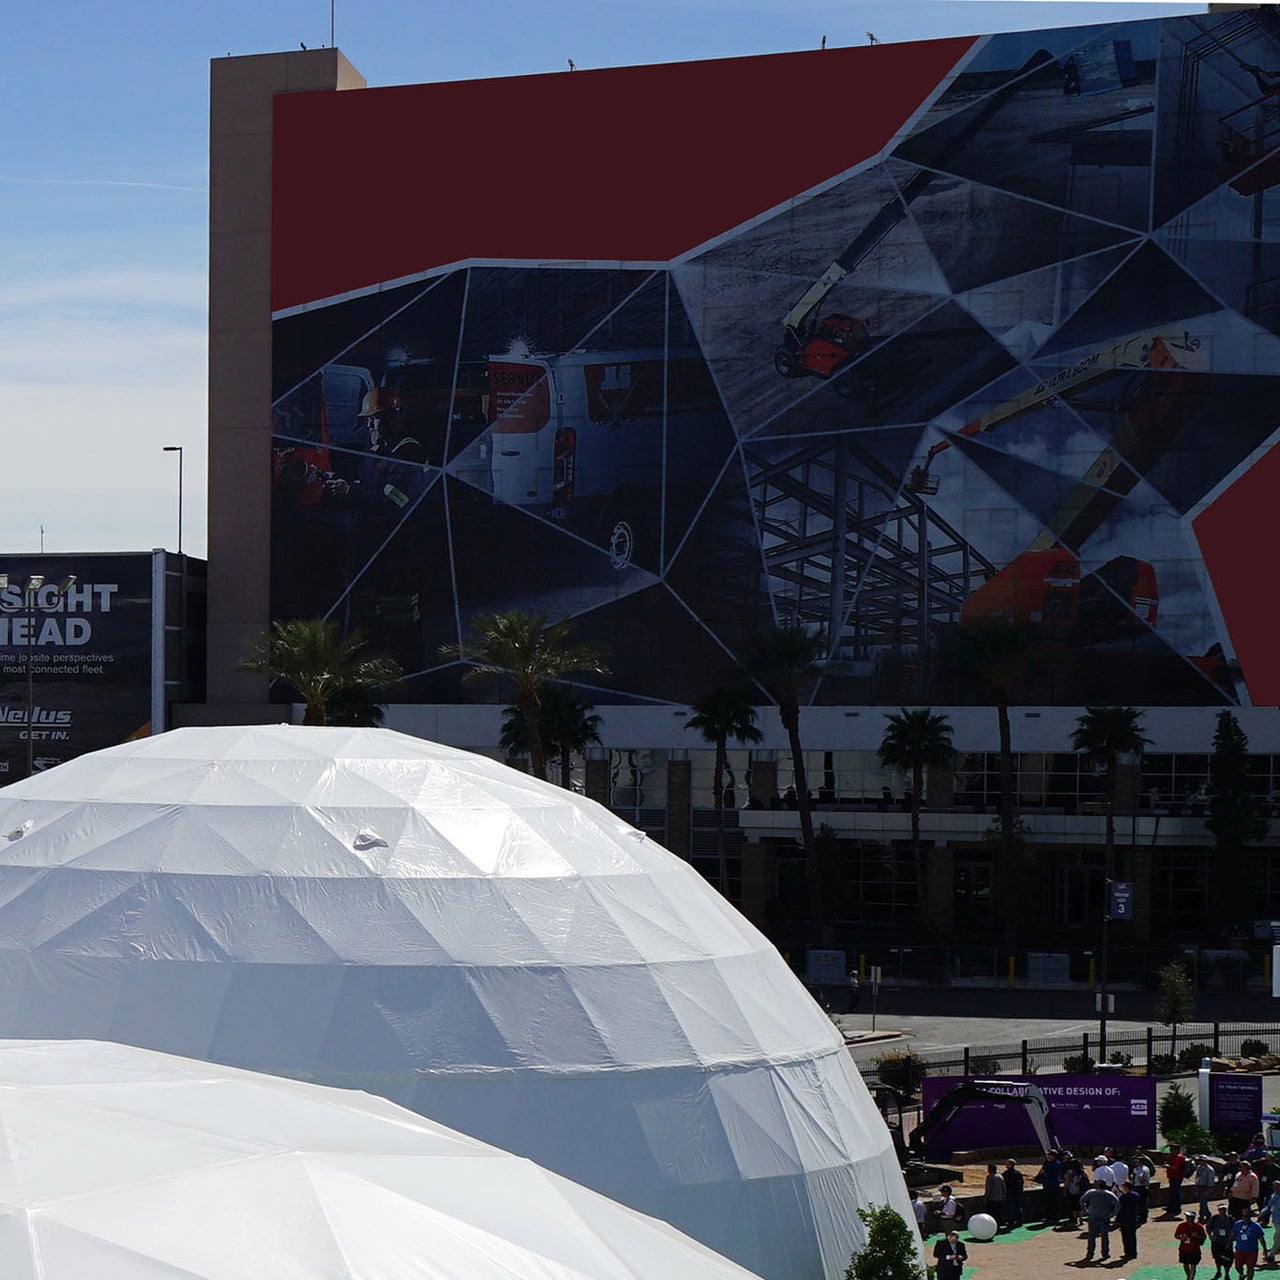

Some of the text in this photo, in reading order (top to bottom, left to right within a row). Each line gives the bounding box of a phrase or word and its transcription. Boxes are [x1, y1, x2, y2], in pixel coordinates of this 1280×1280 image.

[53, 652, 114, 664] perspectives
[3, 664, 27, 674] most
[31, 664, 80, 674] connected
[82, 664, 106, 674] fleet.
[19, 731, 70, 740] GET IN.
[1117, 903, 1126, 914] 3
[1066, 1087, 1103, 1096] DESIGN
[1105, 1087, 1121, 1096] OF:
